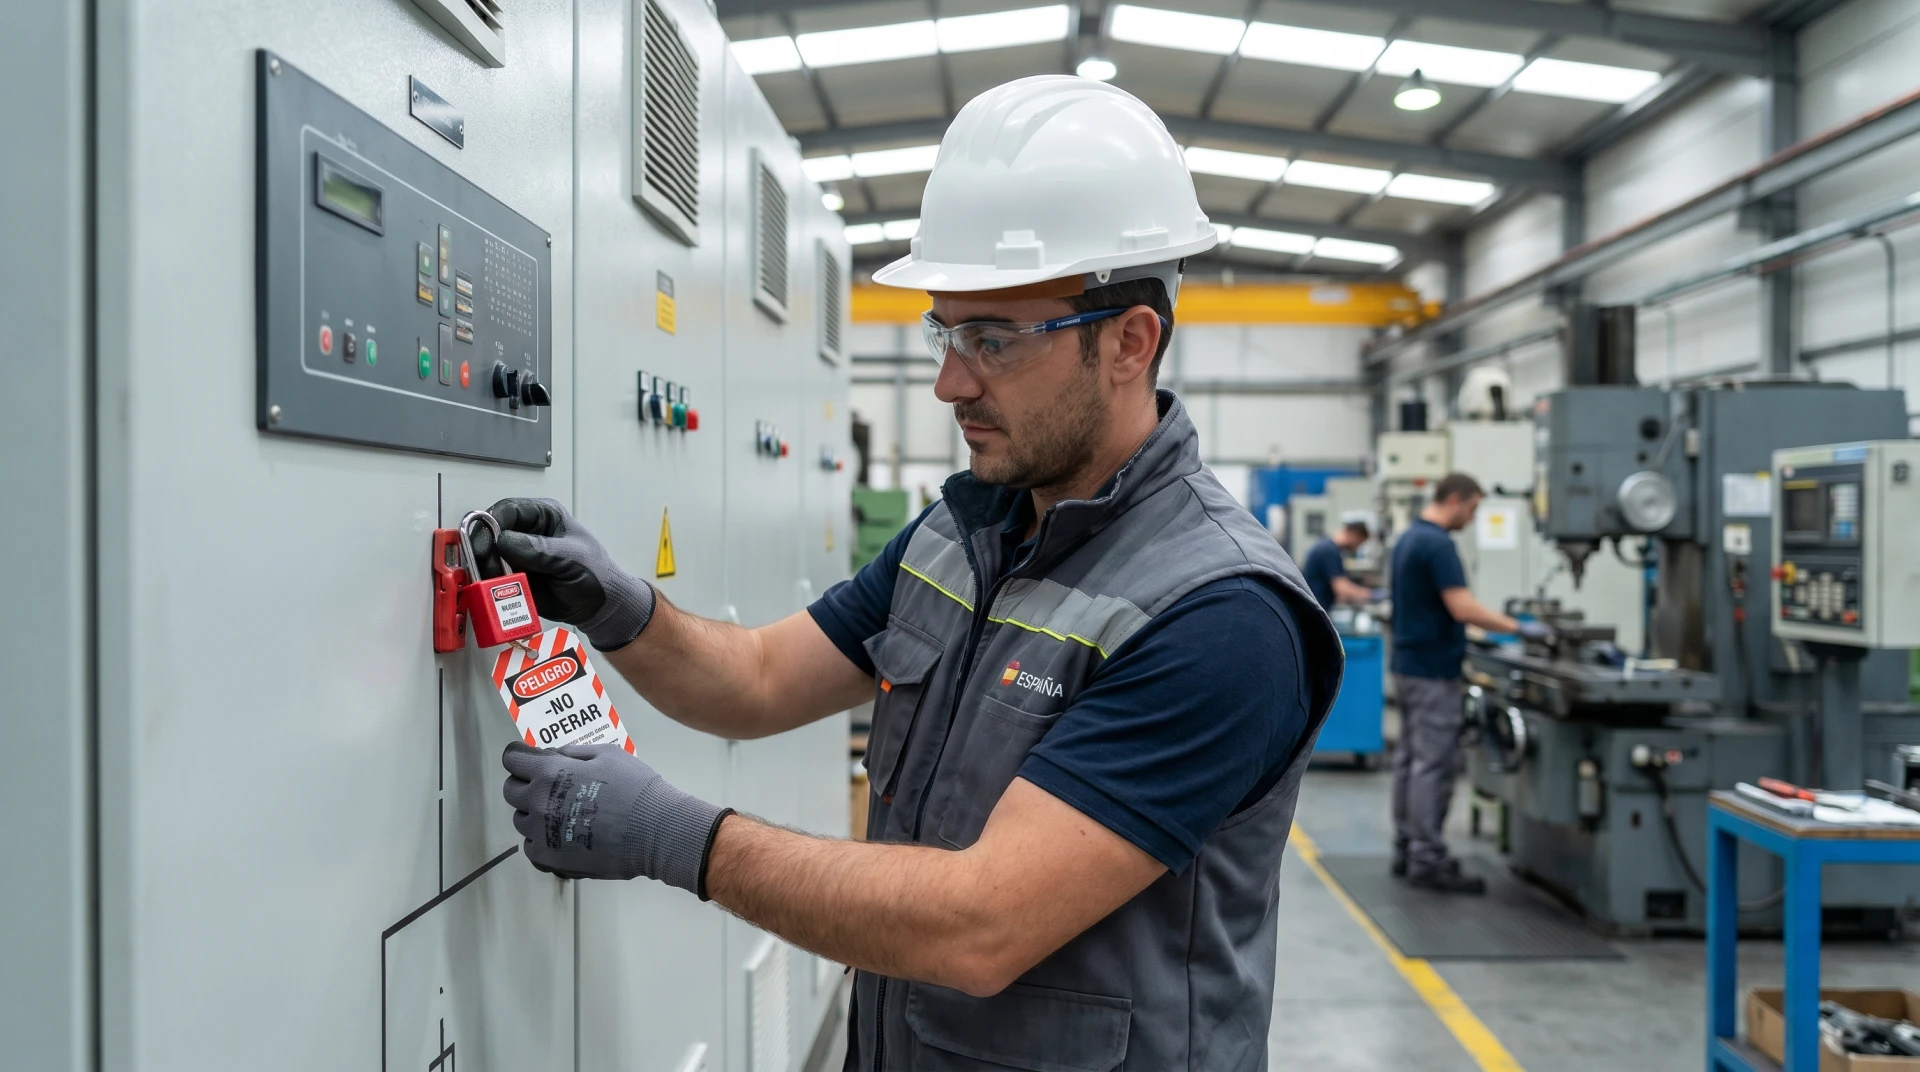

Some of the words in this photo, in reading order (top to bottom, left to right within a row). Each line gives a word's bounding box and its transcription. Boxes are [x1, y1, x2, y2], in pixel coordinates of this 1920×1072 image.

[518, 660, 572, 694] PELIGRO
[1016, 671, 1063, 697] ESPAÑA
[538, 703, 602, 744] OPERAR
